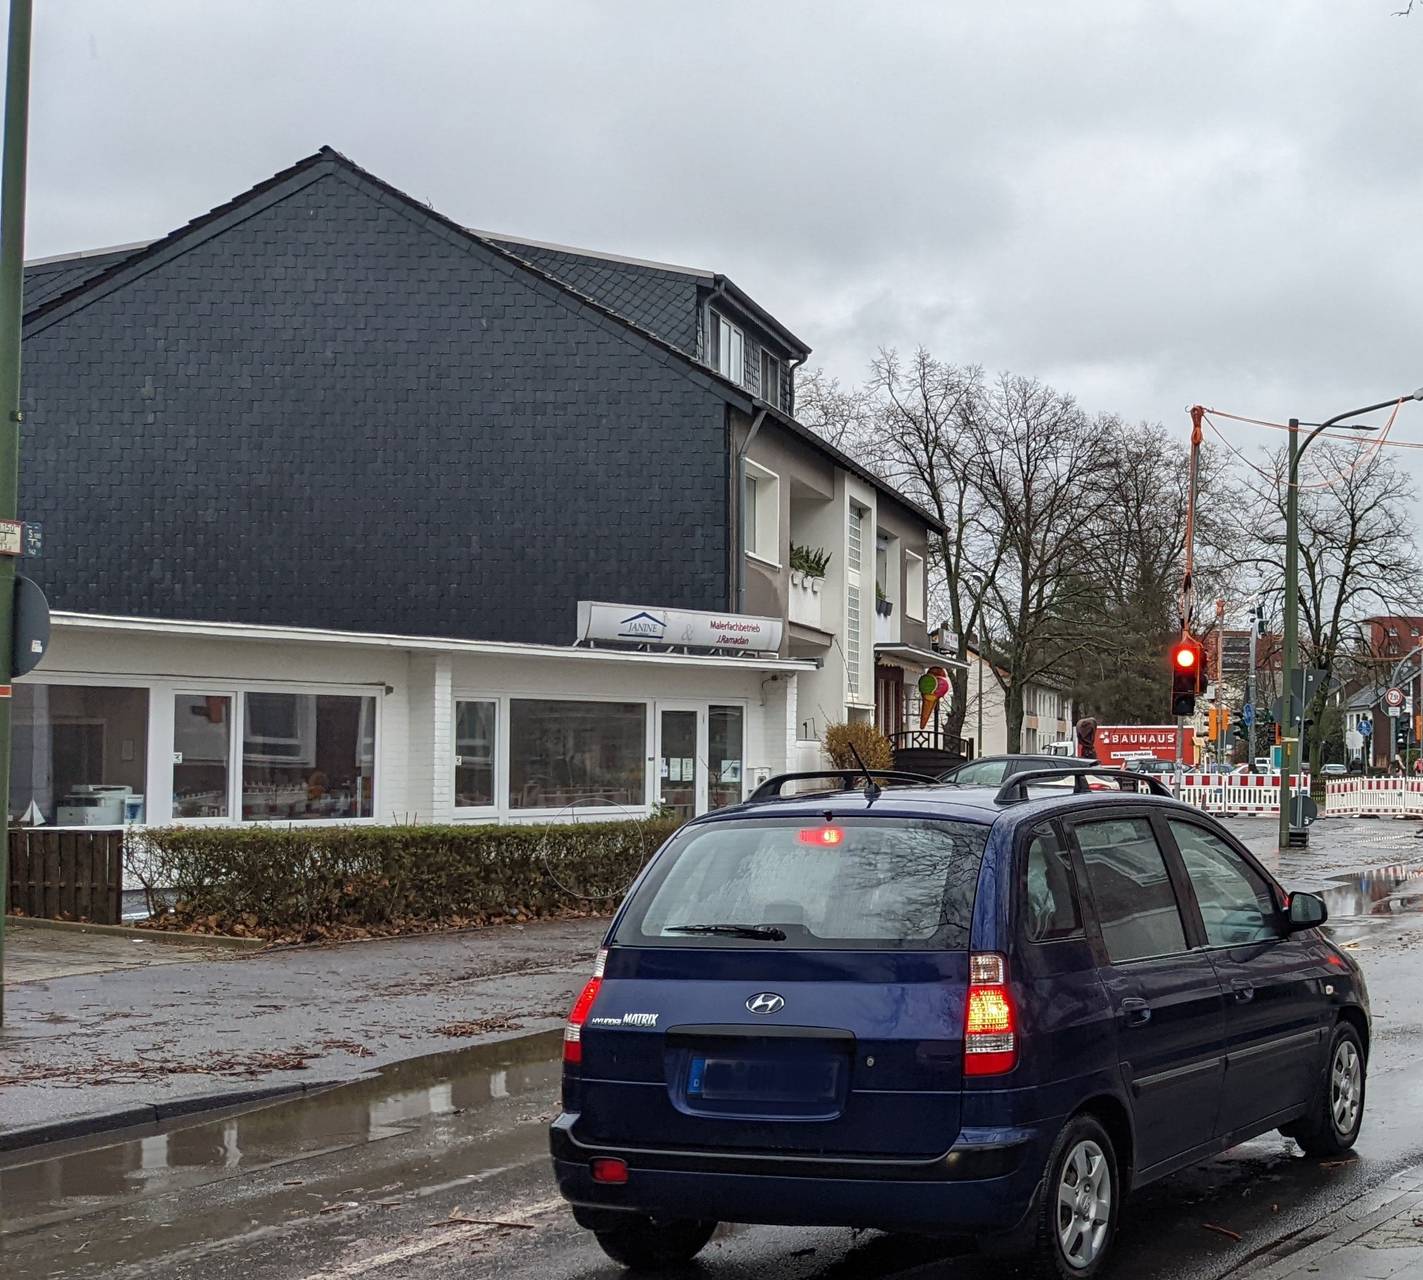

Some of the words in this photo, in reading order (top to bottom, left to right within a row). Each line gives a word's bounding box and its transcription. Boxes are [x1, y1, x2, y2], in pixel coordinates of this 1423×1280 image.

[628, 622, 658, 633] JANINE
[710, 620, 761, 633] Malerfachbetrieb
[1111, 734, 1175, 743] BAUHAUS
[623, 1013, 659, 1027] MATRIX
